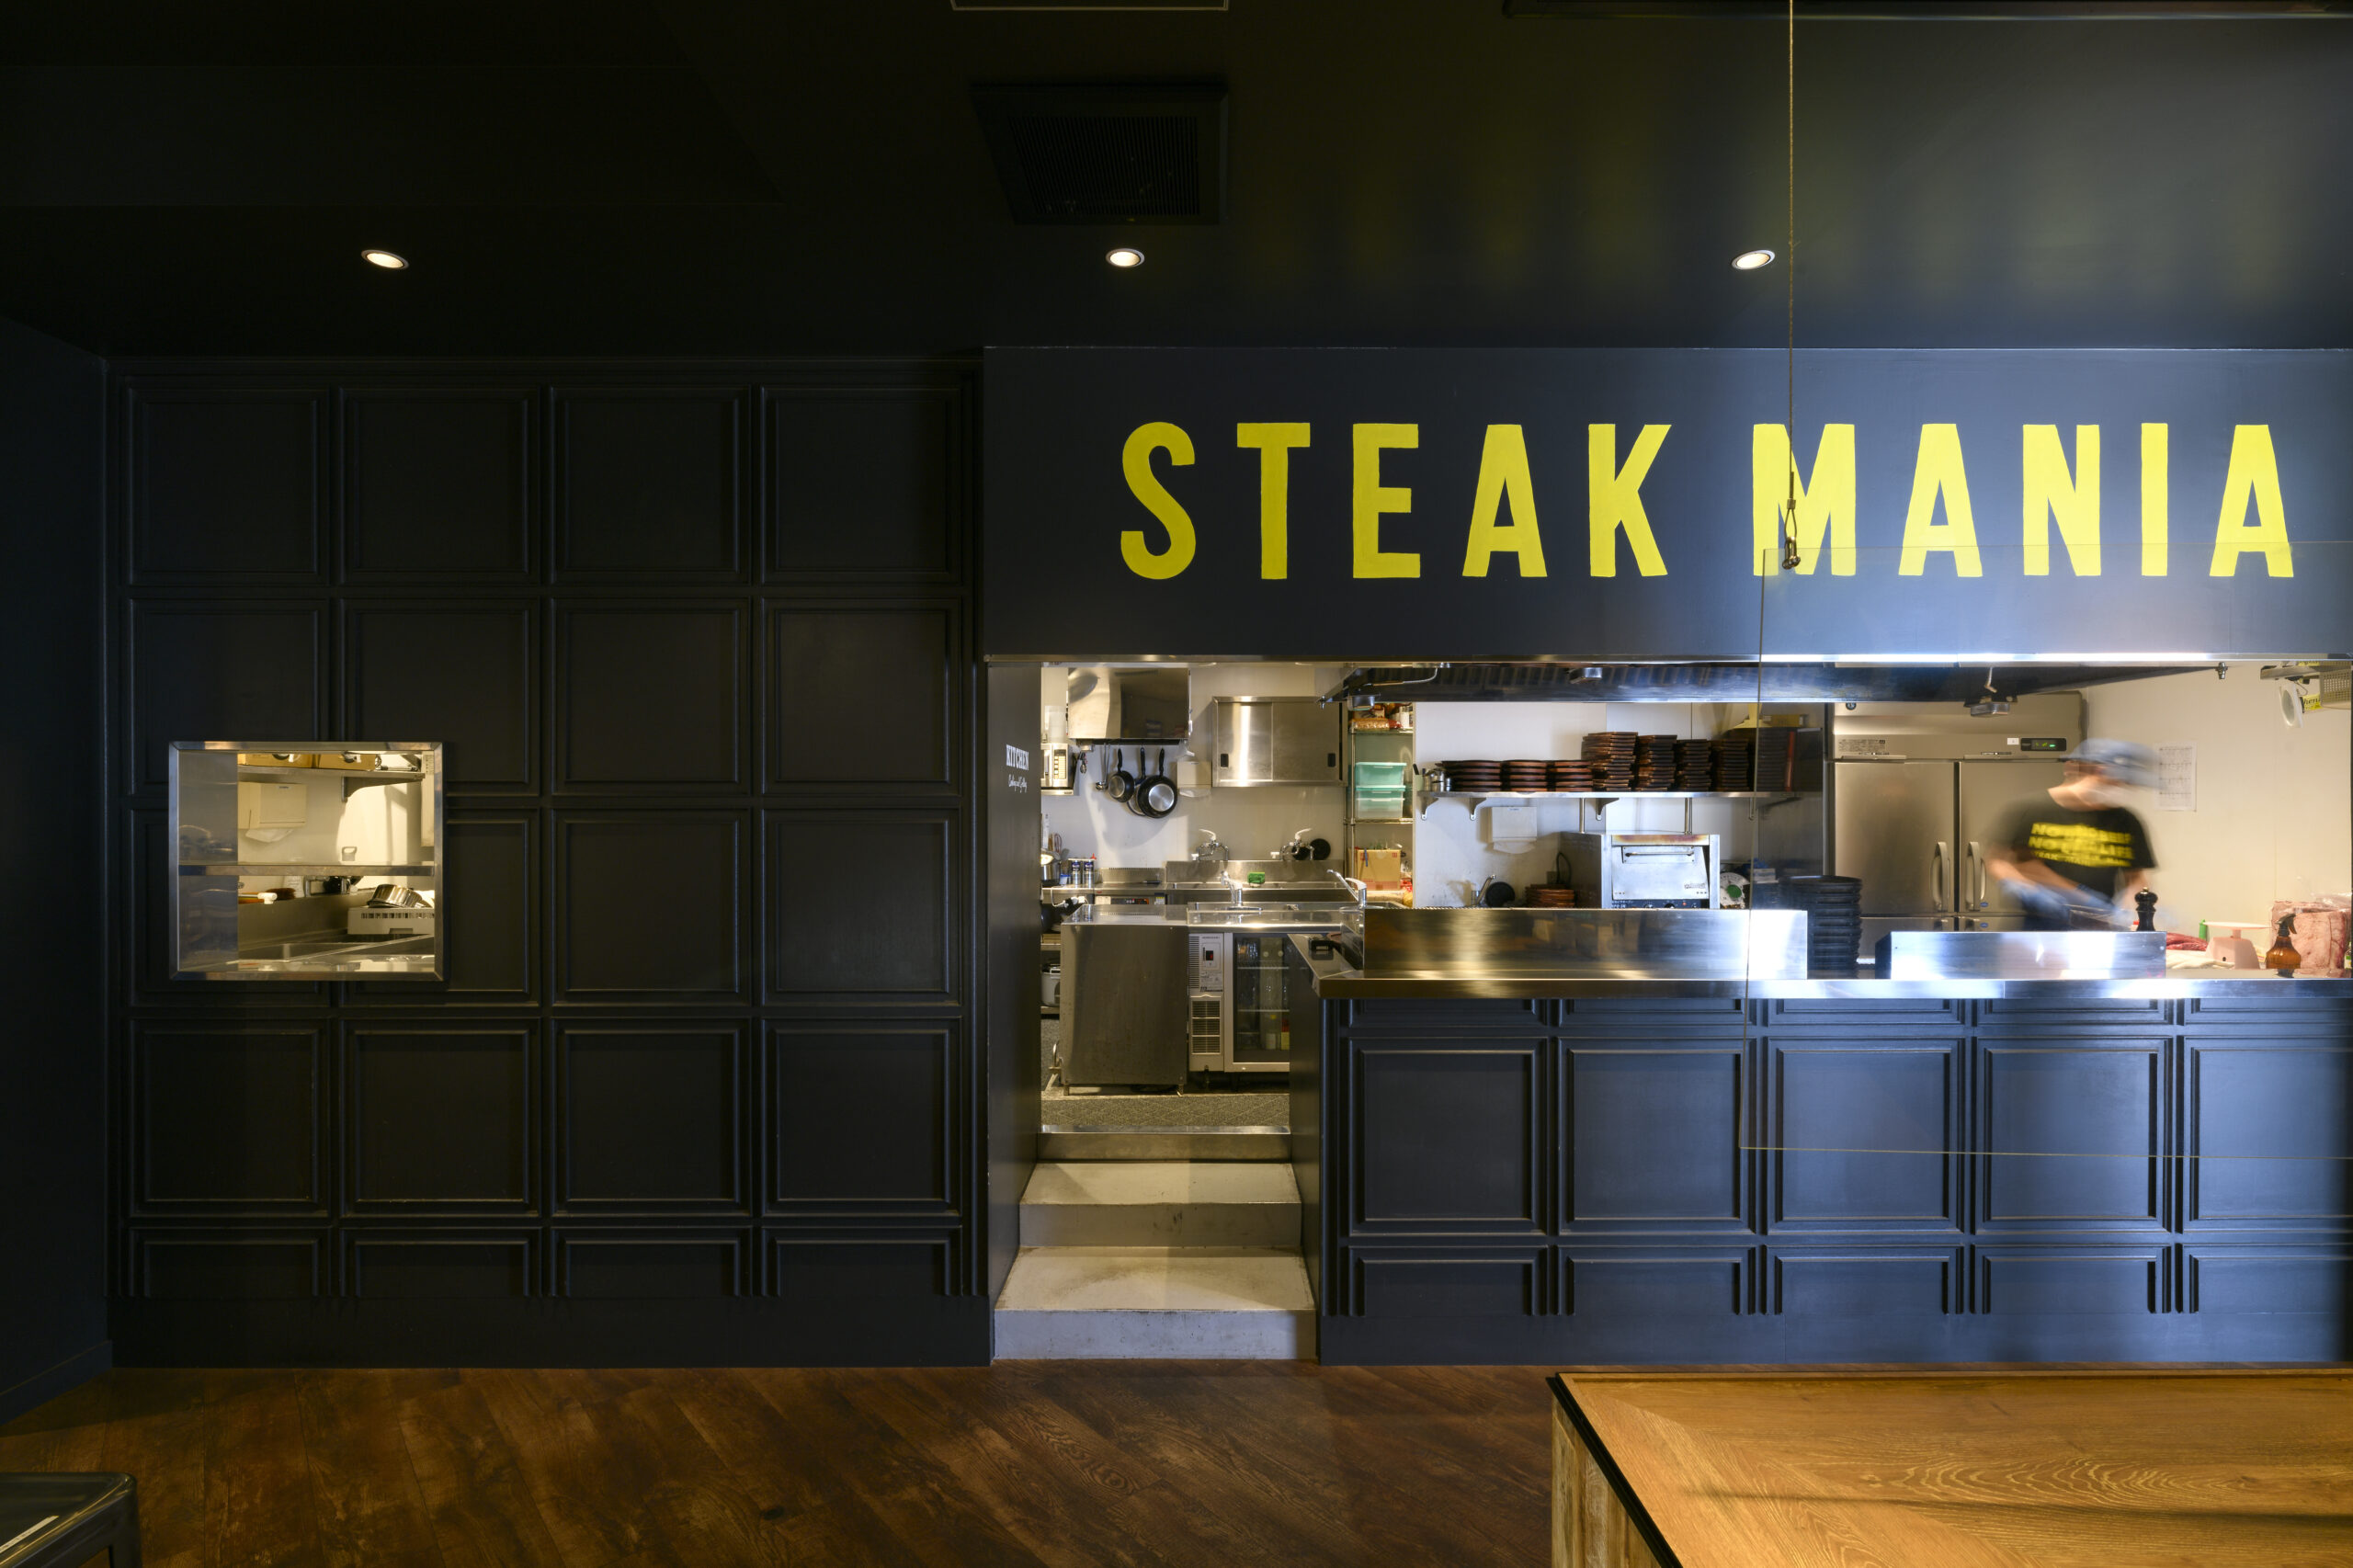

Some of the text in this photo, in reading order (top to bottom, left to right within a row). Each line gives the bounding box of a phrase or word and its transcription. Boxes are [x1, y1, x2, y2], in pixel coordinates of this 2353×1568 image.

[1120, 421, 2294, 580] STEAK MANIA
[1006, 744, 1029, 771] KITCHEN
